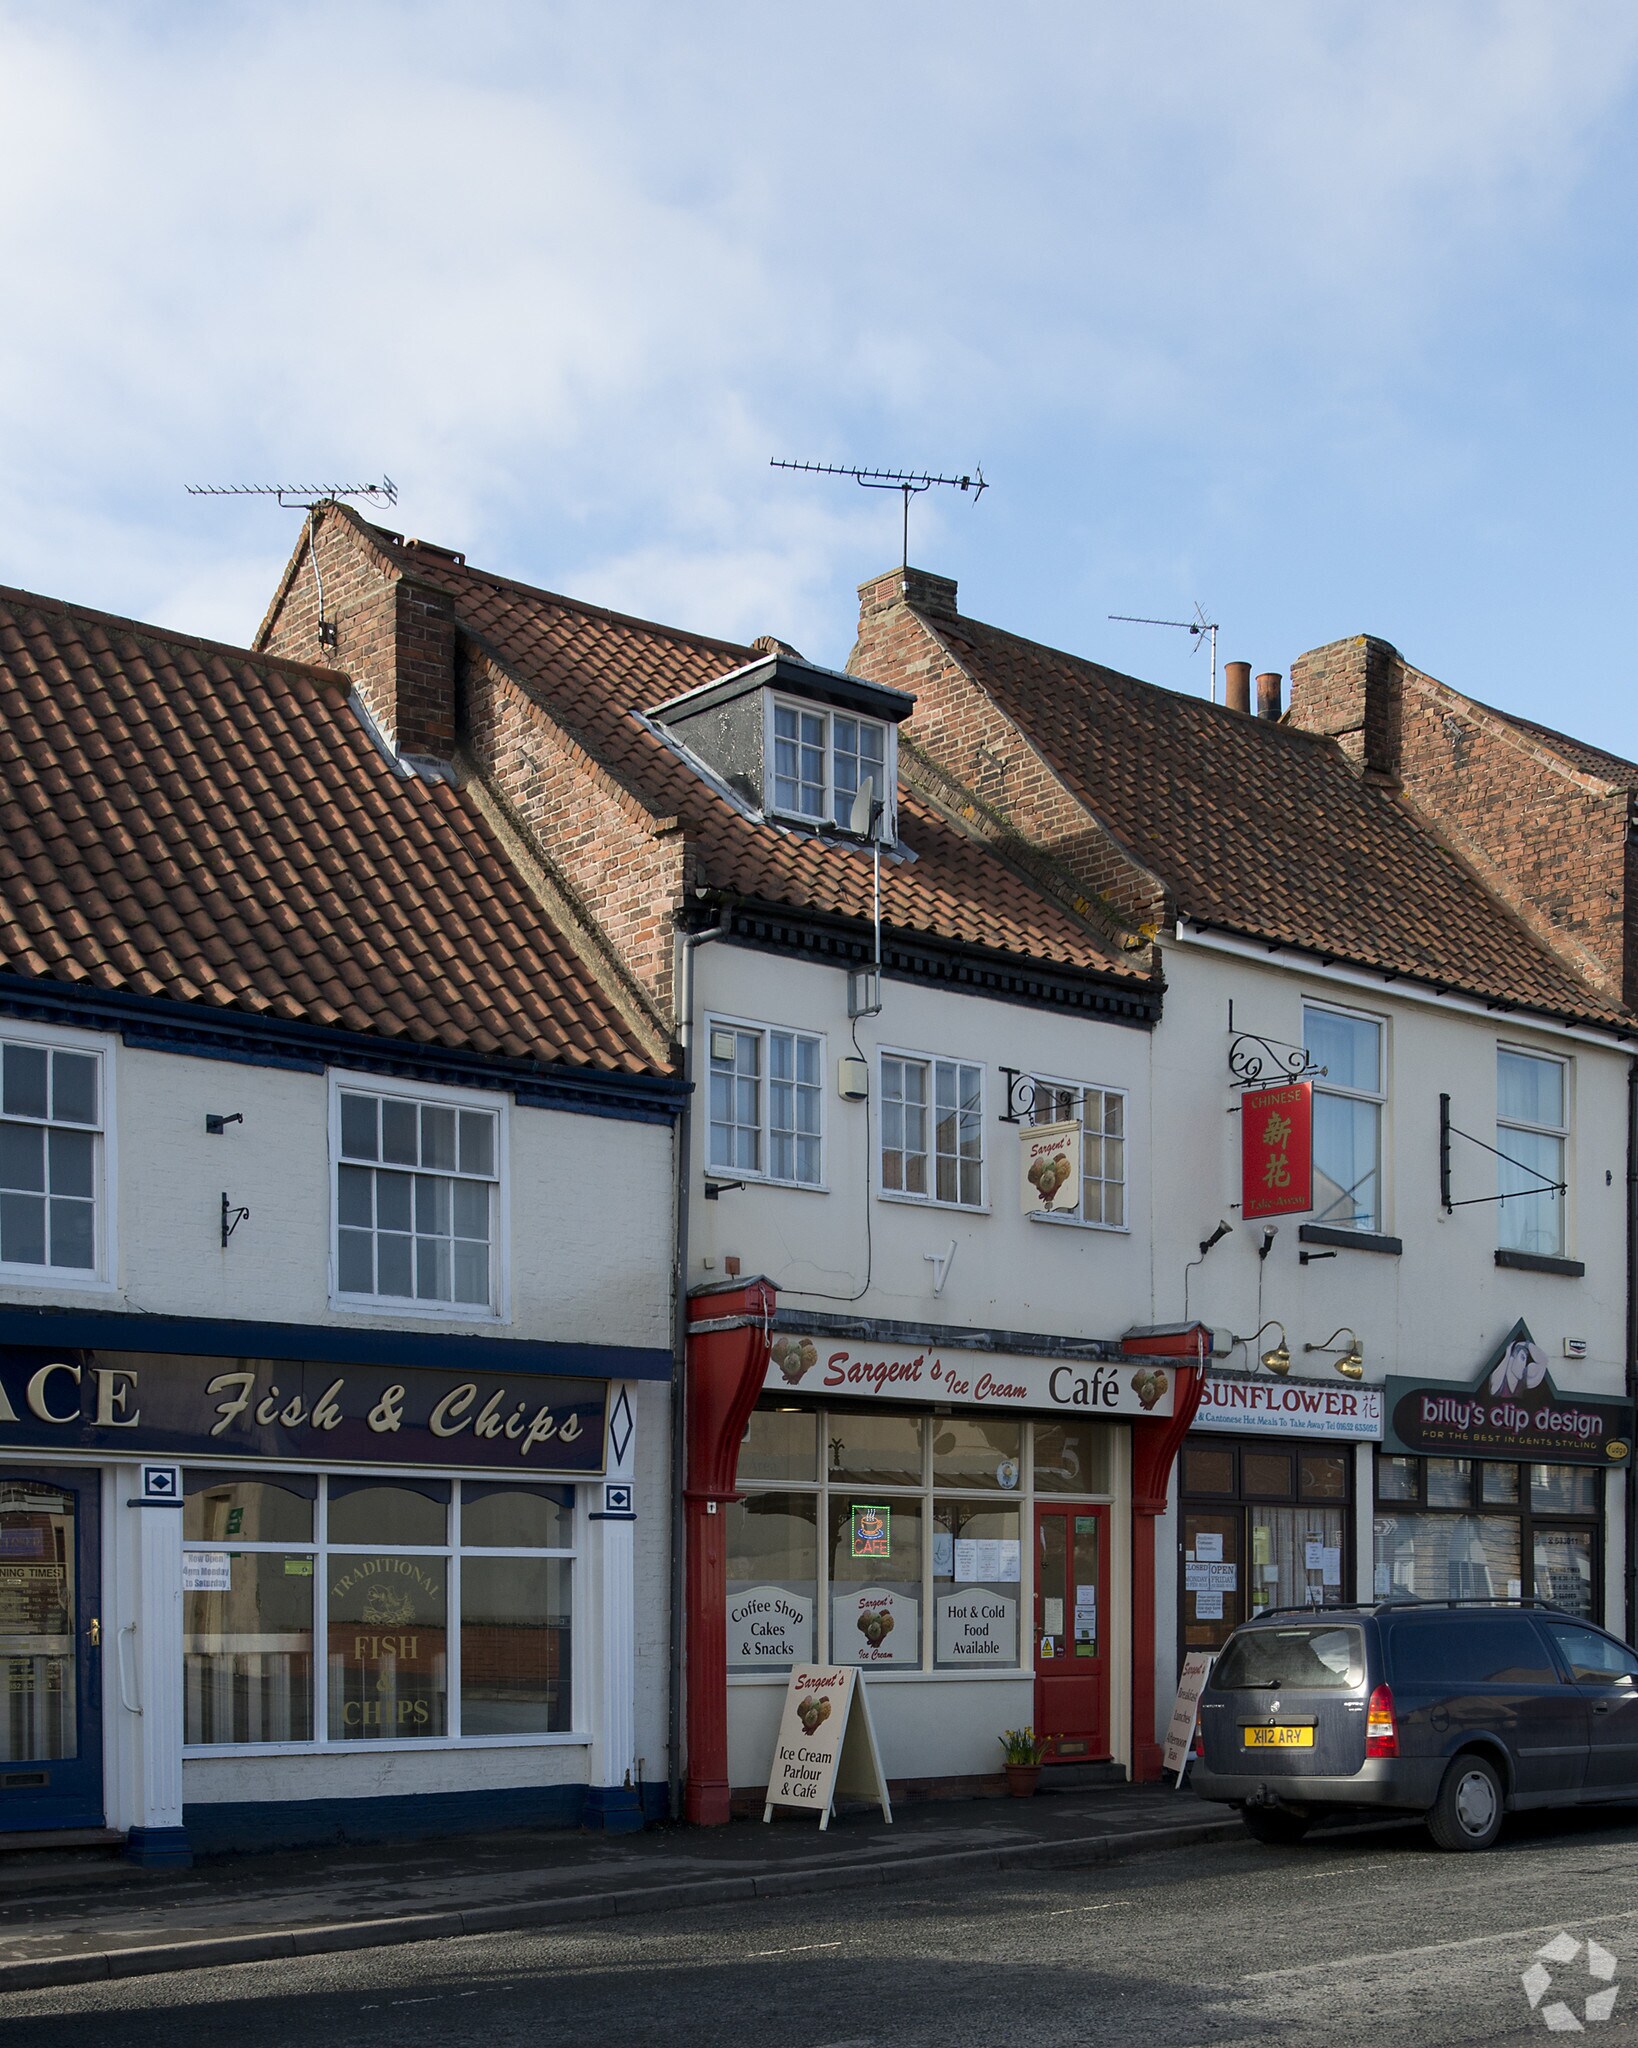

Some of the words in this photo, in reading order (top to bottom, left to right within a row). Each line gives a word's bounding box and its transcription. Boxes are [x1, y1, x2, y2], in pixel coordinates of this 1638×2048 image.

[1251, 1089, 1302, 1109] CHINESE
[1030, 1134, 1071, 1157] Sargent's
[1262, 1110, 1292, 1189] 新花
[823, 1347, 942, 1393] Sargent's
[944, 1369, 969, 1395] Ice
[974, 1373, 1028, 1401] Cream
[1049, 1366, 1120, 1407] Café
[1199, 1383, 1358, 1417] SUNFLOWER
[1362, 1394, 1380, 1419] 花
[205, 1371, 345, 1437] Fish
[366, 1383, 405, 1434] &
[428, 1382, 583, 1456] Chips
[1198, 1412, 1205, 1421] &
[1205, 1412, 1242, 1424] Cantonese
[1243, 1415, 1256, 1424] Hot
[1257, 1415, 1278, 1426] Meals
[1279, 1417, 1288, 1427] To
[1290, 1418, 1306, 1428] Take
[1306, 1420, 1325, 1431] Away
[1325, 1420, 1336, 1430] Tel
[1421, 1396, 1486, 1432] billy's
[1488, 1401, 1531, 1436] clip
[1532, 1406, 1604, 1441] design
[1422, 1430, 1444, 1439] FOR
[1448, 1432, 1469, 1440] THE
[1473, 1433, 1501, 1442] BEST
[1519, 1437, 1552, 1446] GENTS
[1555, 1440, 1597, 1449] STYLING
[1061, 1437, 1080, 1480] 5
[854, 1538, 888, 1555] CAFE
[205, 1554, 224, 1563] Open
[29, 1568, 61, 1578] TIMES
[182, 1566, 200, 1576] 4pm
[201, 1567, 229, 1576] Monday
[1211, 1565, 1234, 1575] OPEN
[186, 1579, 193, 1587] to
[194, 1579, 227, 1588] Saturday
[330, 1557, 442, 1601] TRADITIONAL
[1211, 1576, 1234, 1584] FRIDAY
[857, 1594, 894, 1610] Sargent's
[731, 1599, 772, 1623] Coffee
[774, 1599, 804, 1625] Shop
[948, 1605, 967, 1618] Hot
[970, 1605, 978, 1619] &
[981, 1605, 1005, 1619] Cold
[751, 1621, 785, 1636] Cakes
[964, 1623, 989, 1636] Food
[354, 1635, 419, 1661] FISH
[741, 1642, 752, 1656] &
[754, 1640, 795, 1656] Snacks
[858, 1649, 870, 1659] Ice
[870, 1649, 893, 1660] Cream
[952, 1640, 1000, 1654] Available
[375, 1669, 394, 1692] &
[794, 1669, 845, 1693] Sargent's
[1177, 1687, 1198, 1703] Breakfast
[342, 1699, 430, 1726] CHIPS
[1173, 1709, 1191, 1725] Lunches
[1278, 1729, 1302, 1744] ARY
[779, 1746, 795, 1760] Ice
[797, 1747, 832, 1764] Cream
[783, 1764, 822, 1781] Parlour
[781, 1782, 790, 1796] &
[793, 1782, 817, 1799] Café
